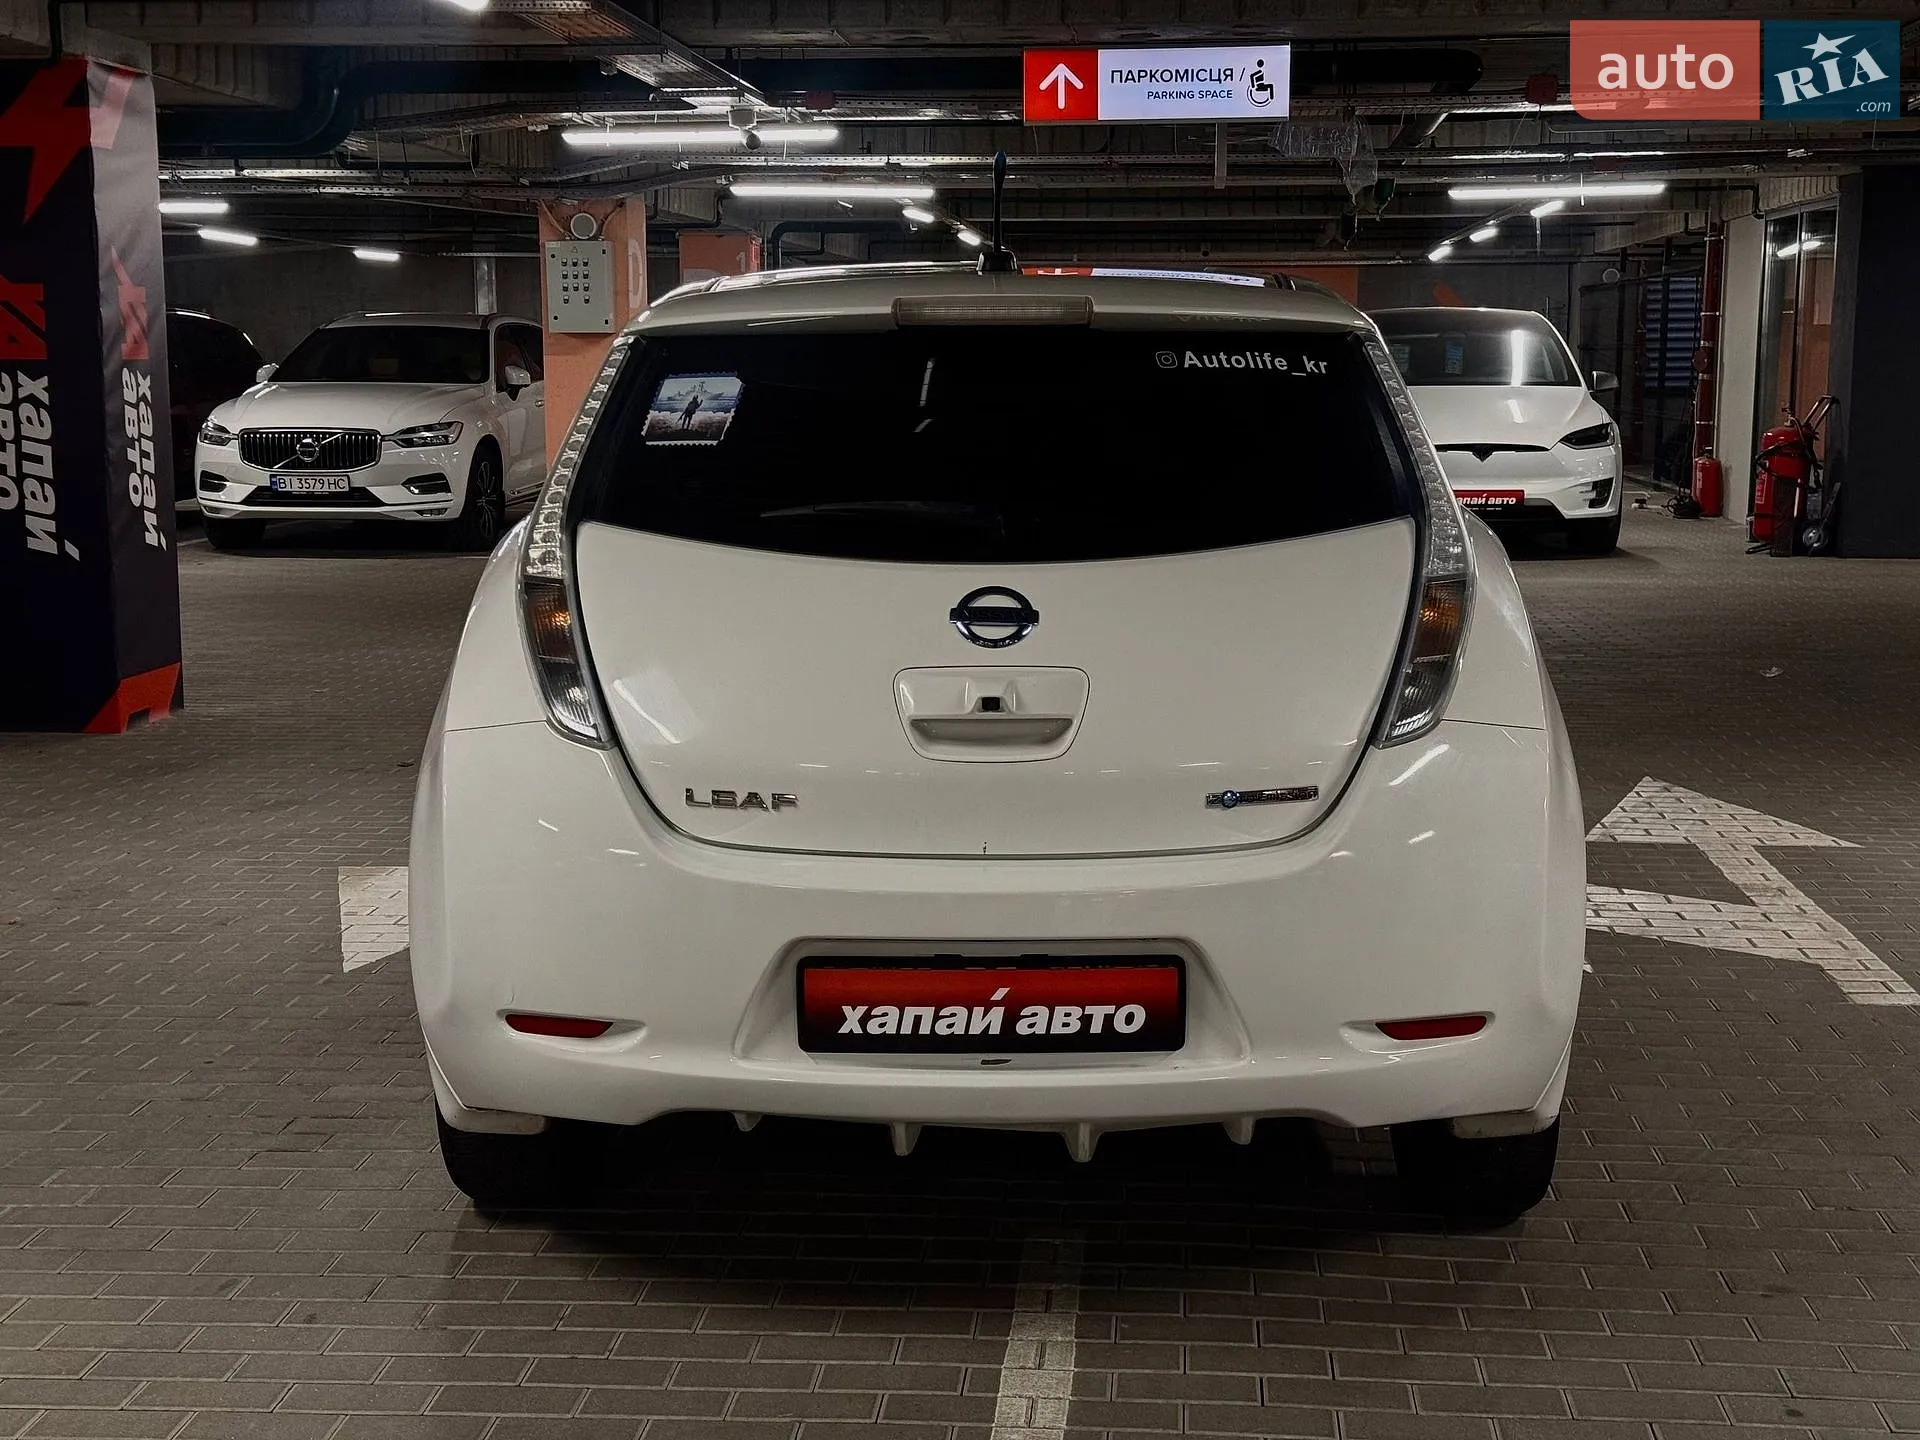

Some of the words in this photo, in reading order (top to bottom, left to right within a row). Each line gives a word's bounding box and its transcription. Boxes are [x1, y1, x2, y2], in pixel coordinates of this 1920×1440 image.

[1110, 68, 1234, 84] ПАРКОМІСЦЯ
[1147, 90, 1195, 100] PARKING
[1198, 89, 1233, 99] SPACE
[1183, 351, 1328, 376] Autolife_kr
[122, 367, 142, 508] авто
[278, 477, 293, 490] BI
[296, 478, 325, 490] 3579
[327, 479, 346, 490] HC
[1456, 493, 1488, 505] апай
[1487, 497, 1517, 505] авто
[685, 788, 799, 812] LEAF
[1015, 1004, 1147, 1035] авто
